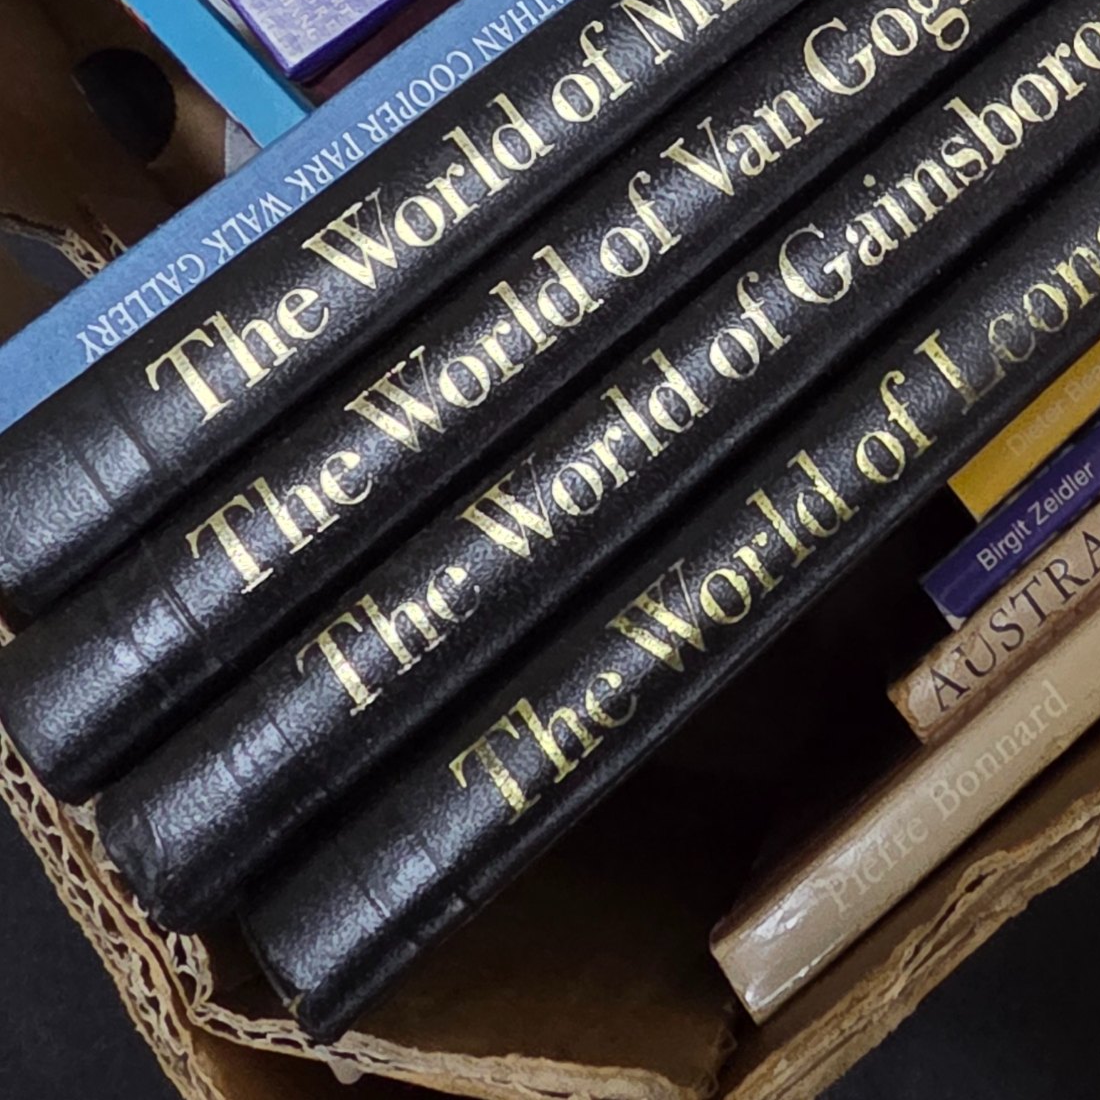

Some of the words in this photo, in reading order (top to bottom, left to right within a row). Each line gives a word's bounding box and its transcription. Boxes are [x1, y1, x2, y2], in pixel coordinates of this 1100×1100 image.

[357, 49, 474, 144] COOPER
[145, 286, 330, 425] The
[301, 92, 556, 289] World
[551, 20, 634, 123] of
[202, 190, 294, 262] WALK
[283, 133, 366, 202] PARK
[74, 250, 207, 364] GALLERY
[185, 449, 372, 594] The
[345, 245, 604, 453] World
[599, 170, 682, 278] of
[661, 88, 823, 197] Van
[296, 564, 481, 716] The
[456, 348, 710, 561] World
[708, 270, 792, 379] of
[976, 520, 1032, 573] Birgit
[1026, 458, 1096, 527] Zeidler
[449, 671, 638, 824] The
[606, 449, 858, 672] World
[855, 370, 934, 483] of
[927, 680, 1069, 821] Bonnard
